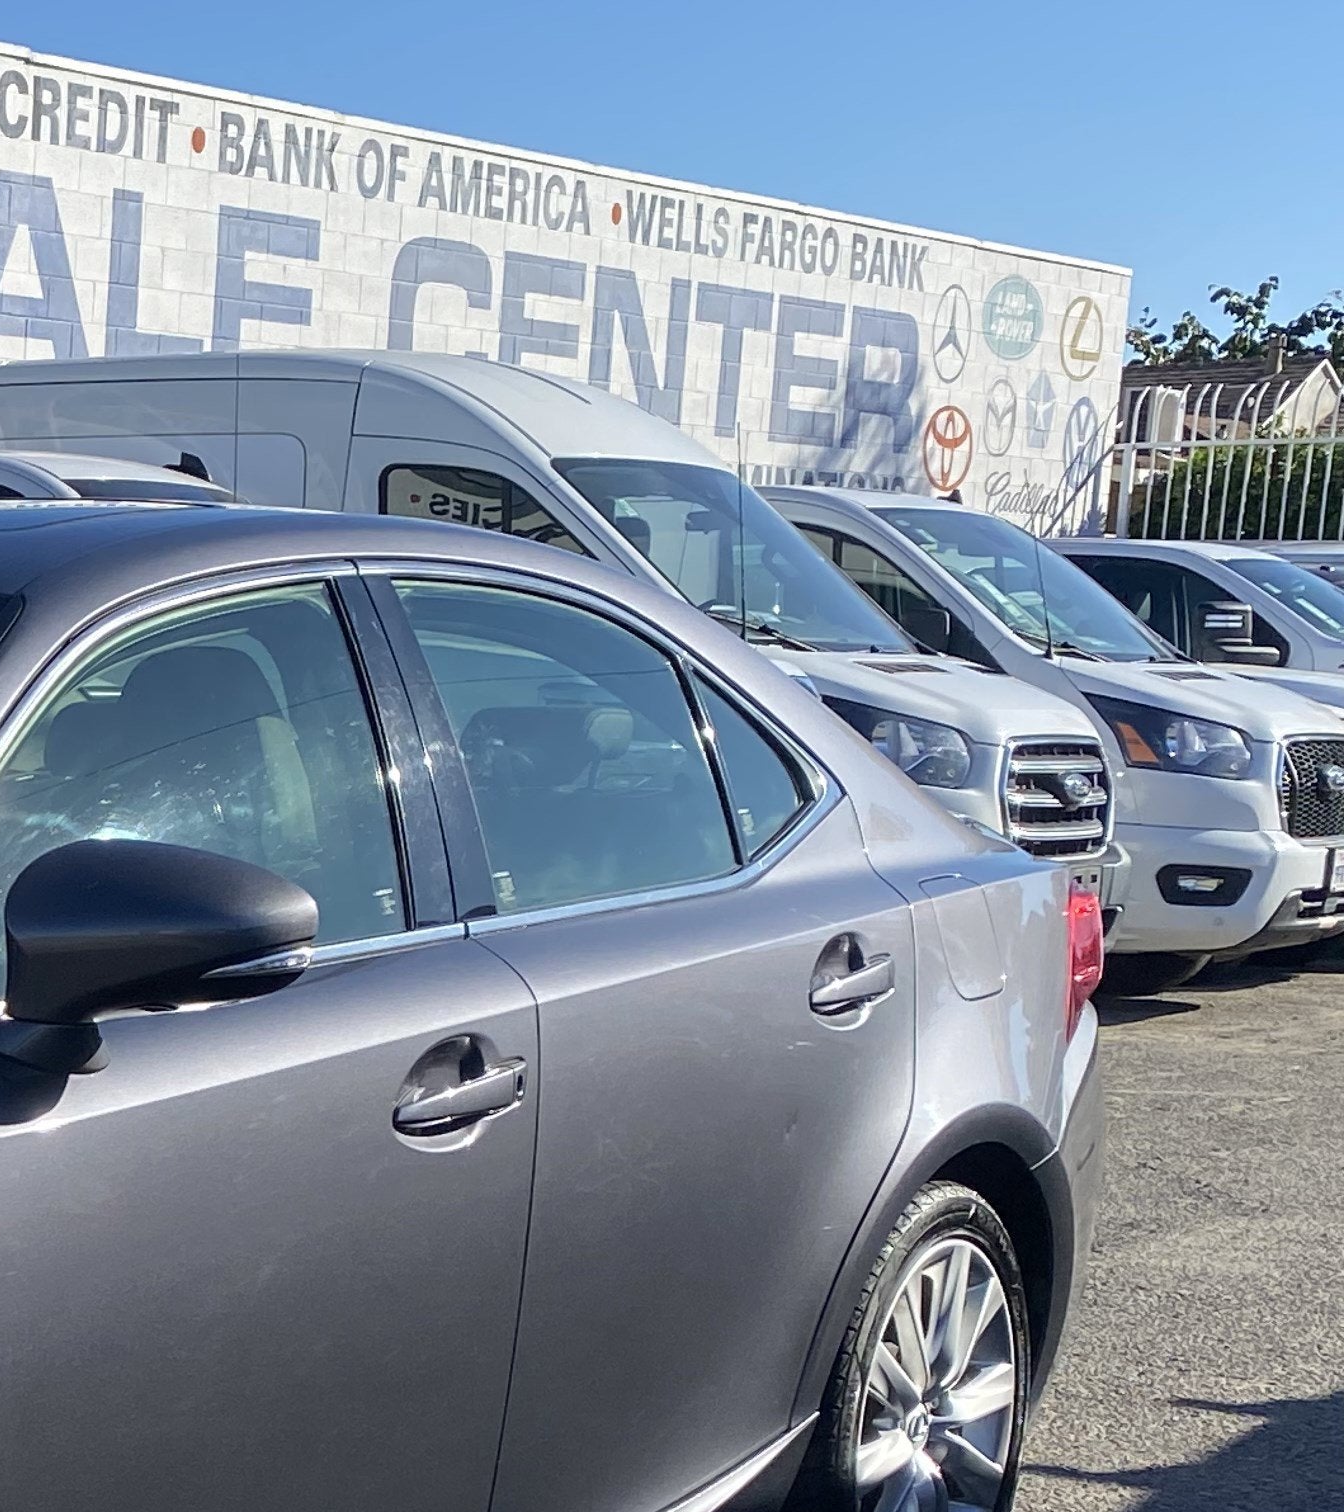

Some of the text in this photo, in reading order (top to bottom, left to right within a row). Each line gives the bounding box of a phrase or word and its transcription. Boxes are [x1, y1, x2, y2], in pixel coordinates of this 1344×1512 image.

[217, 111, 340, 193] BANK
[356, 138, 410, 202] OF
[417, 151, 592, 235] AMERICA
[626, 189, 730, 258] WELLS
[739, 212, 840, 276] FARGO
[849, 233, 929, 292] BANK
[388, 236, 920, 456] CENTER
